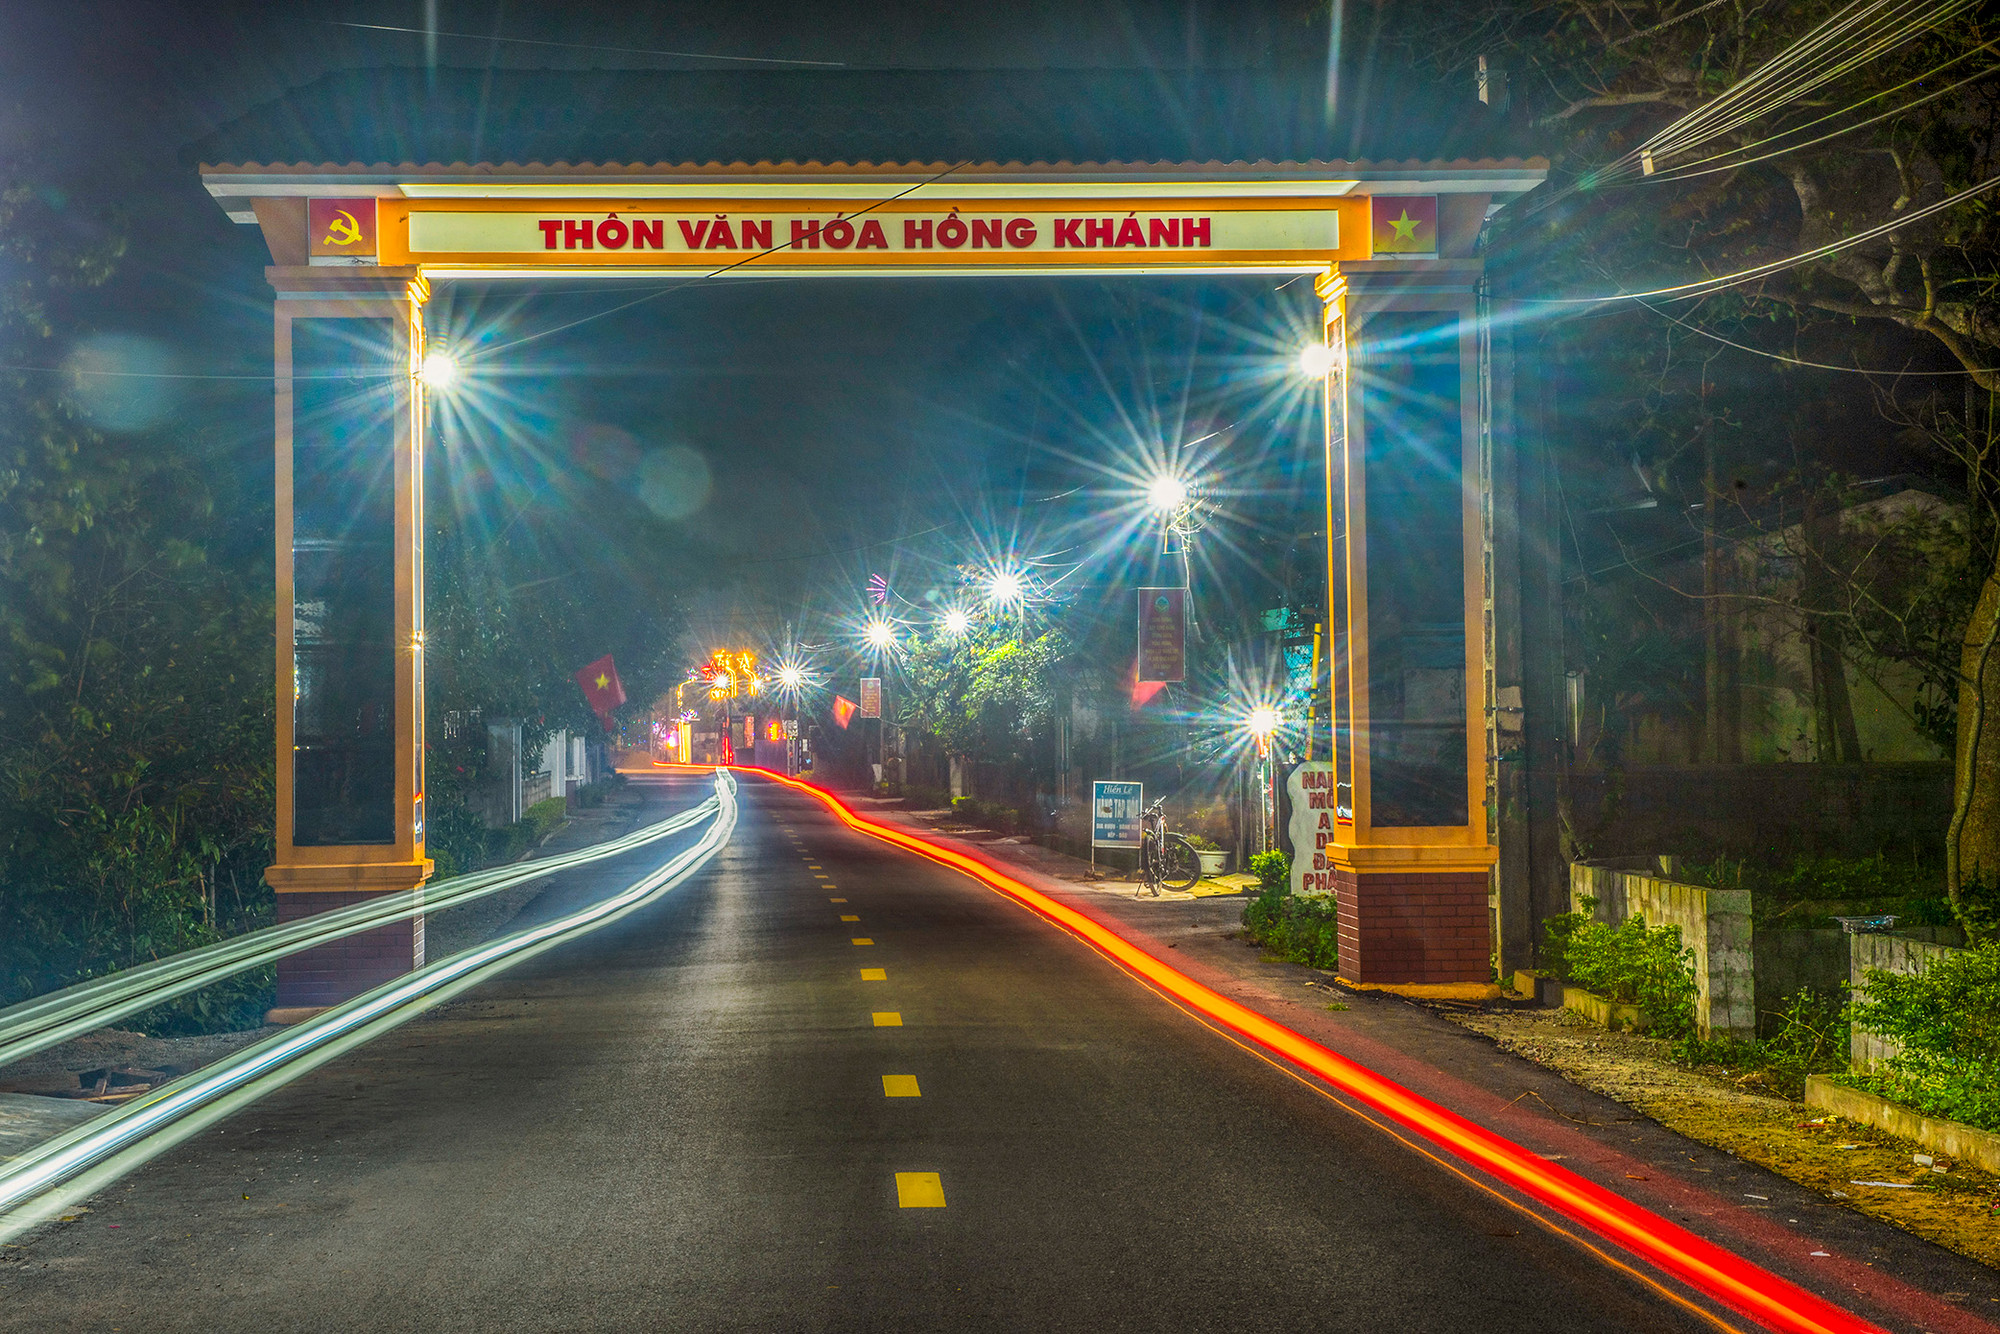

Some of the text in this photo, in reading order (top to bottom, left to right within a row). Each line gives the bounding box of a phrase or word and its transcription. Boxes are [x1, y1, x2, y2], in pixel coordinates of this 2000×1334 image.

[538, 206, 1211, 250] THÔN VĂN HÓA HỒNG KHÁNH
[1318, 812, 1331, 829] A
